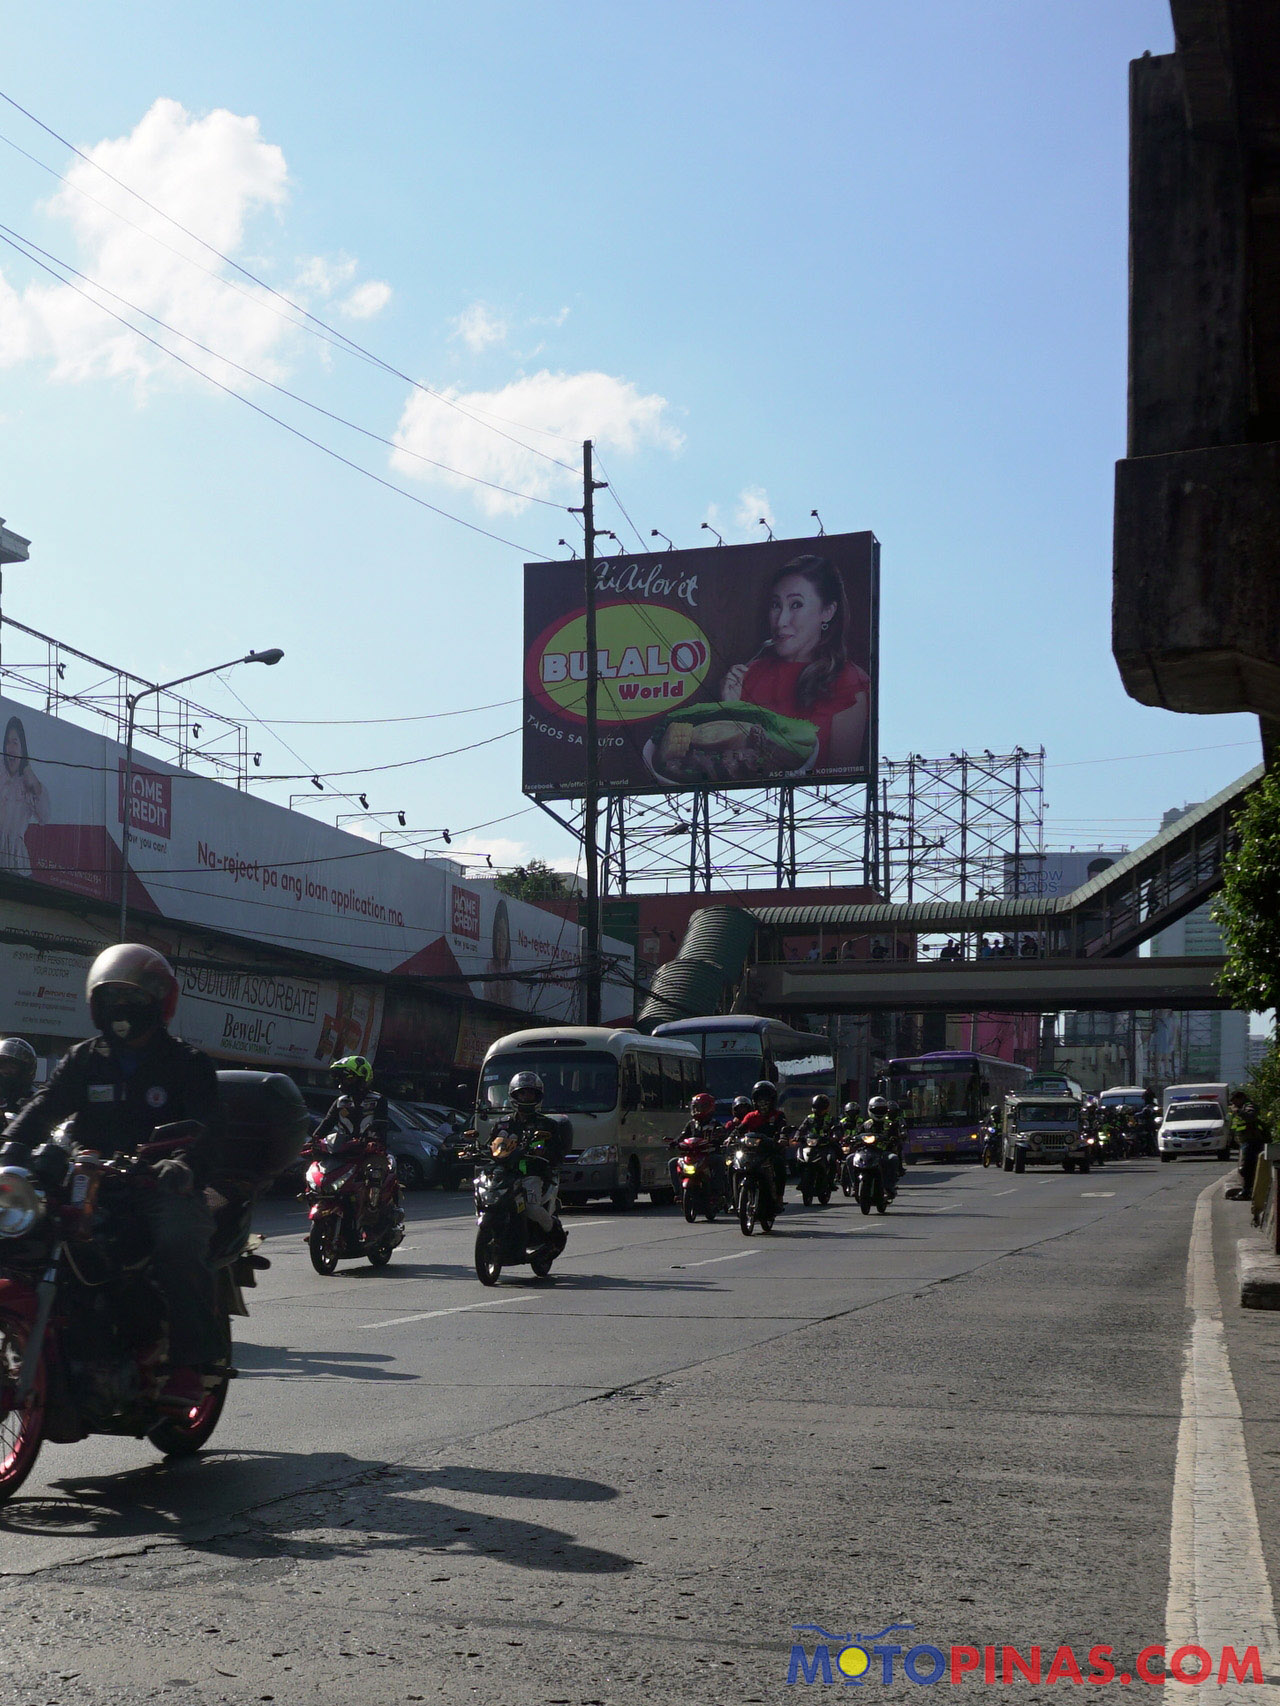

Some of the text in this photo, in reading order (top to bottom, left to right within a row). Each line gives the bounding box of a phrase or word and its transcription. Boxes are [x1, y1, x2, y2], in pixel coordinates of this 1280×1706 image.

[542, 641, 707, 684] BULALO
[618, 680, 684, 701] World
[526, 714, 624, 747] TAGOS SA UTO
[197, 840, 260, 885] Na-reject
[263, 869, 279, 892] pa
[281, 873, 303, 901] ang
[305, 873, 330, 903] loan
[331, 887, 386, 926] application
[454, 892, 477, 915] HOME
[186, 965, 240, 1001] SODIUM
[241, 975, 318, 1018] ASCORBATE
[222, 1012, 277, 1046] Bewell-C
